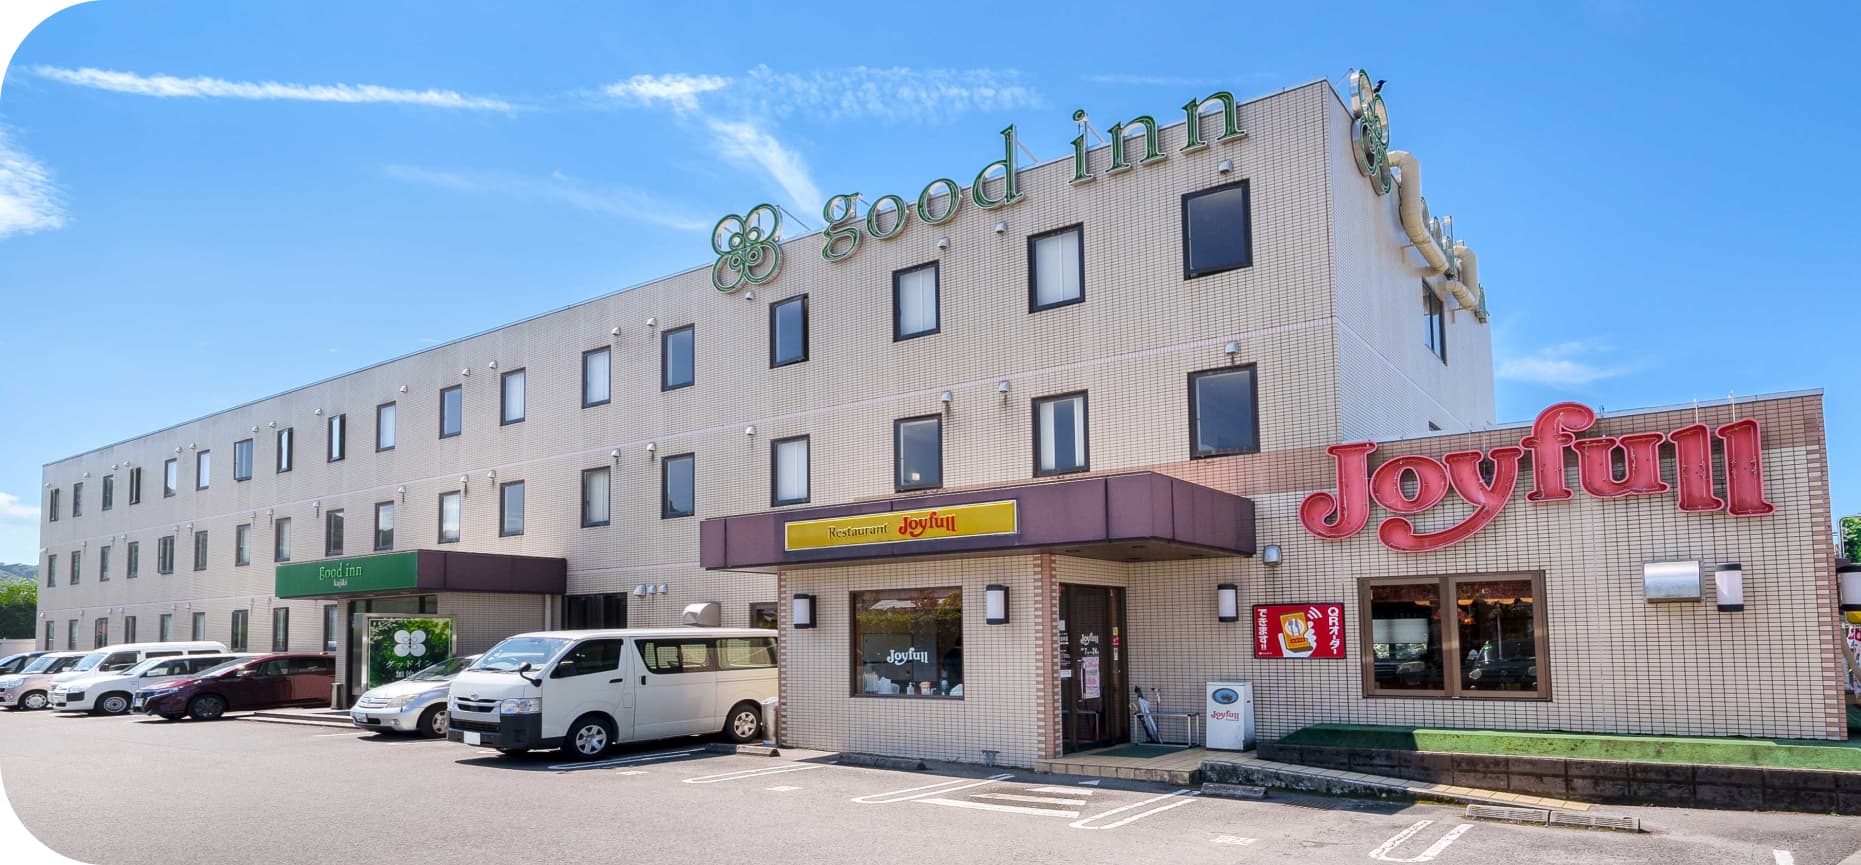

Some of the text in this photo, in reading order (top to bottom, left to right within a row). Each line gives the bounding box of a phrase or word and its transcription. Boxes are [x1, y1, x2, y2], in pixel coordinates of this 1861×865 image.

[821, 91, 1248, 263] good inn
[1298, 401, 1776, 553] Joyfull
[828, 511, 957, 540] Restaurant Joyfull
[319, 563, 362, 581] good inn
[1327, 606, 1340, 655] QRオーダー
[886, 647, 928, 666] Joyfull
[1210, 710, 1240, 720] Joyfull
